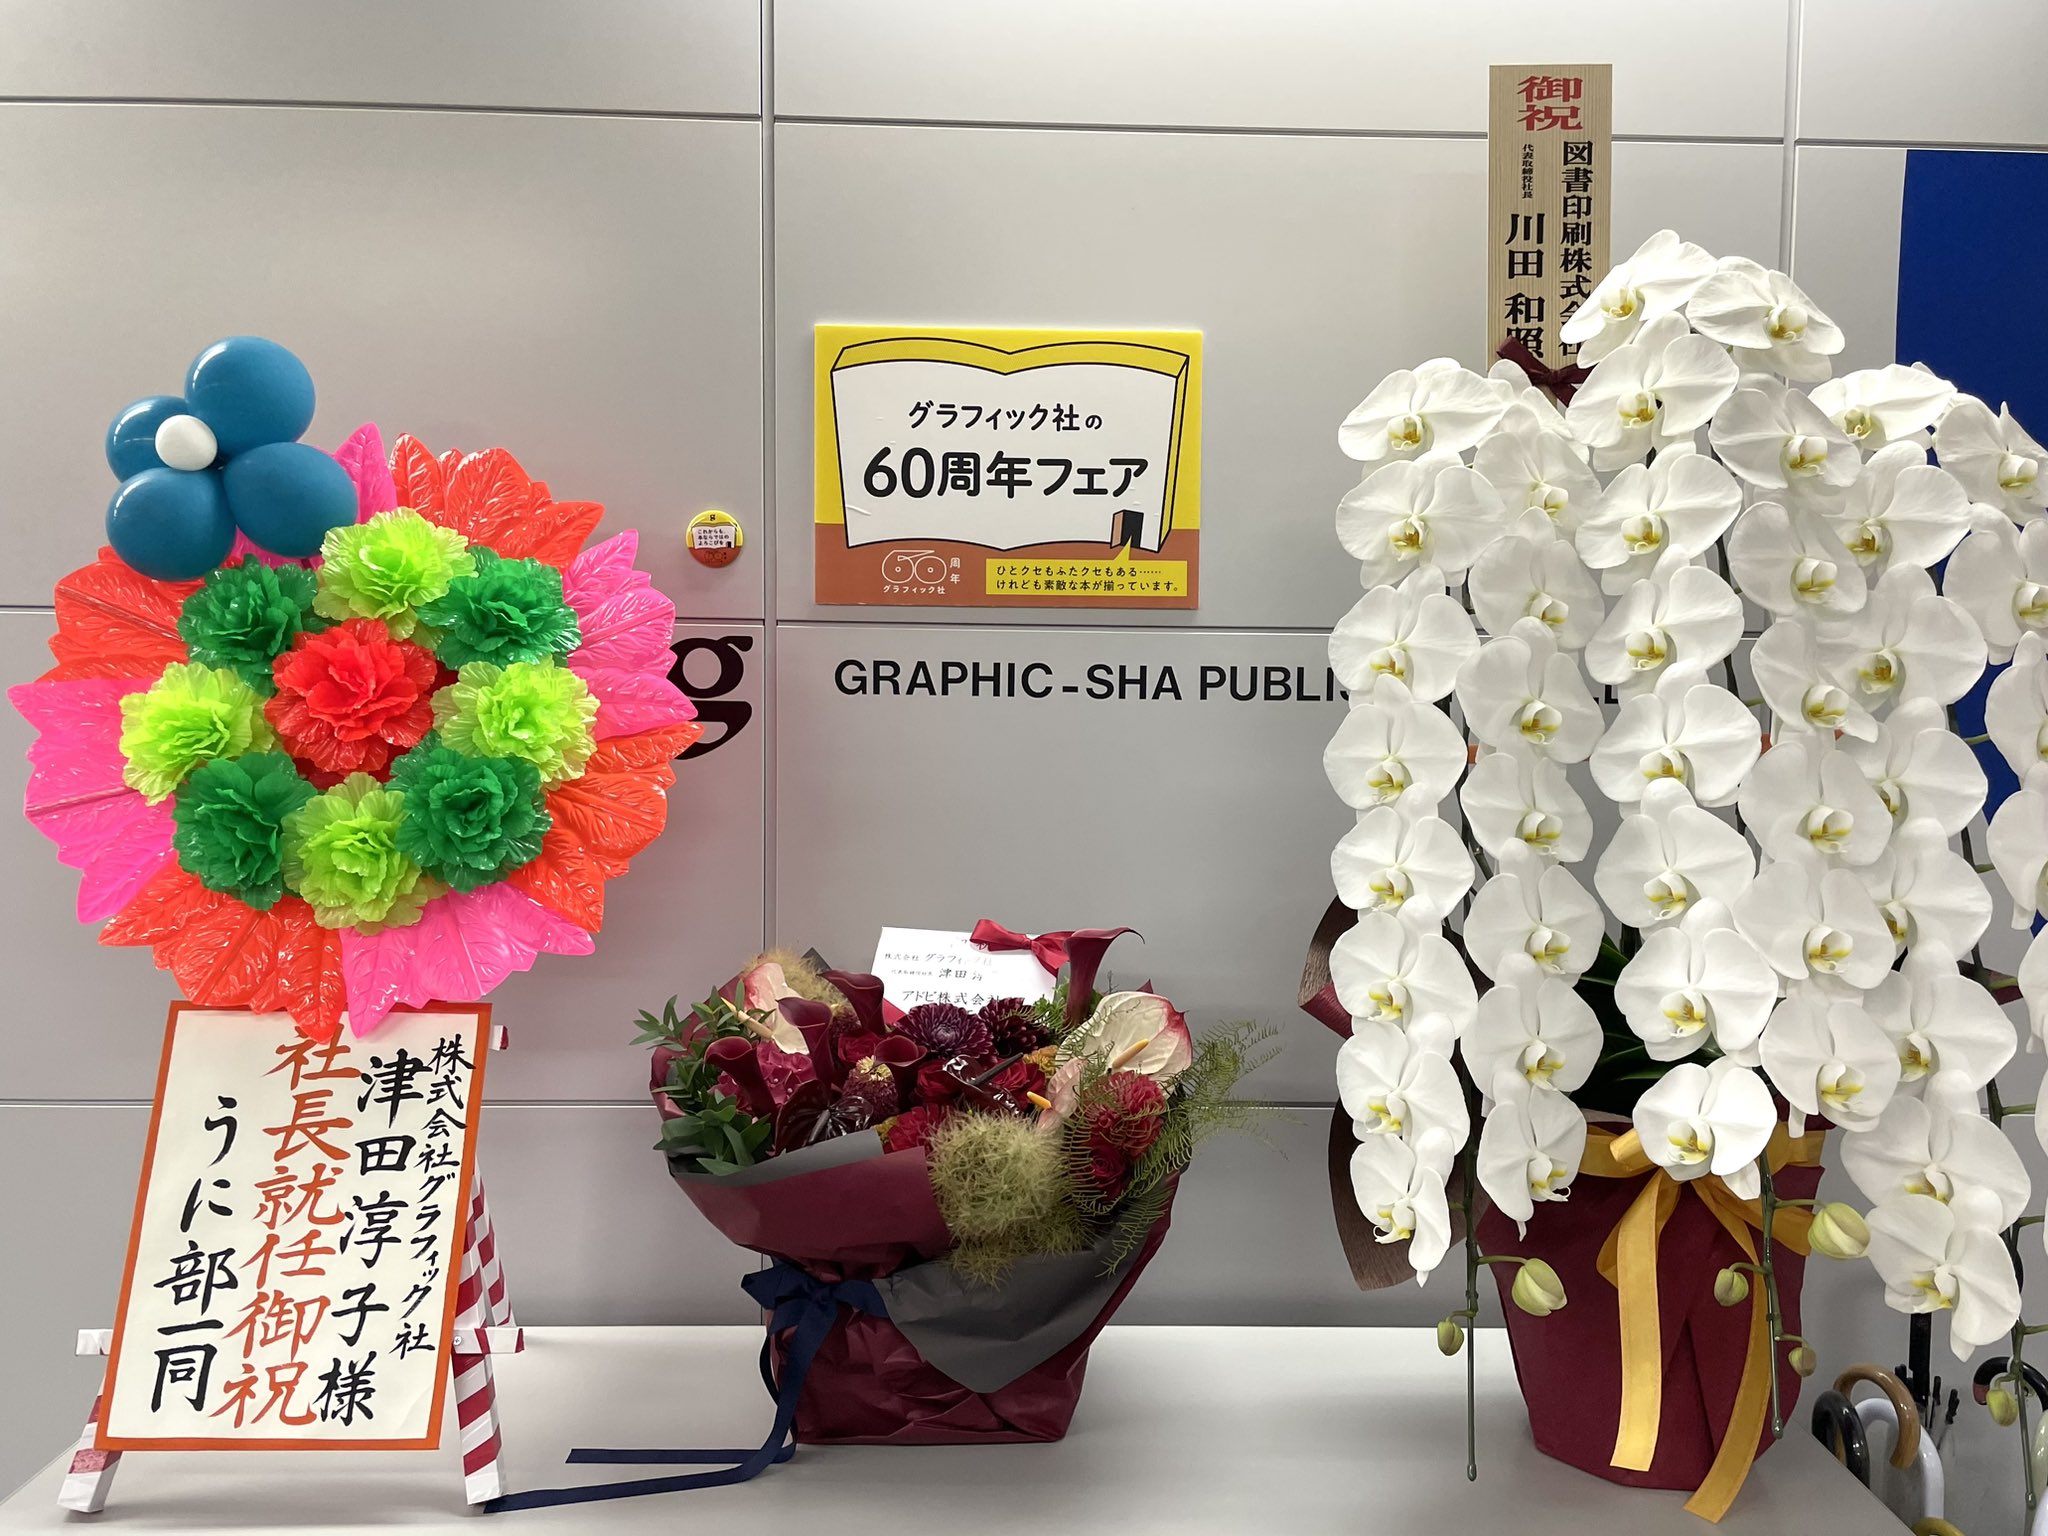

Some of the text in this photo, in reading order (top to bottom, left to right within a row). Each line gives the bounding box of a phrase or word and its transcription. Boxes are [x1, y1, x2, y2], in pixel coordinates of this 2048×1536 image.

[1517, 75, 1583, 132] 御祝
[908, 400, 1102, 432] グラフィック社の
[863, 446, 1149, 499] 60周年フェア
[883, 584, 946, 595] グラフィック社
[949, 557, 961, 585] 周年
[996, 579, 1179, 592] けれども素敵な本が揃っています。
[666, 635, 754, 760] g
[1199, 665, 1349, 702] PUBLI
[388, 1033, 477, 1360] 株式会社グラフィック社
[208, 1022, 363, 1429] 社長就任御祝
[308, 1048, 433, 1427] 津田淳子様
[150, 1095, 240, 1413] うに部一同
